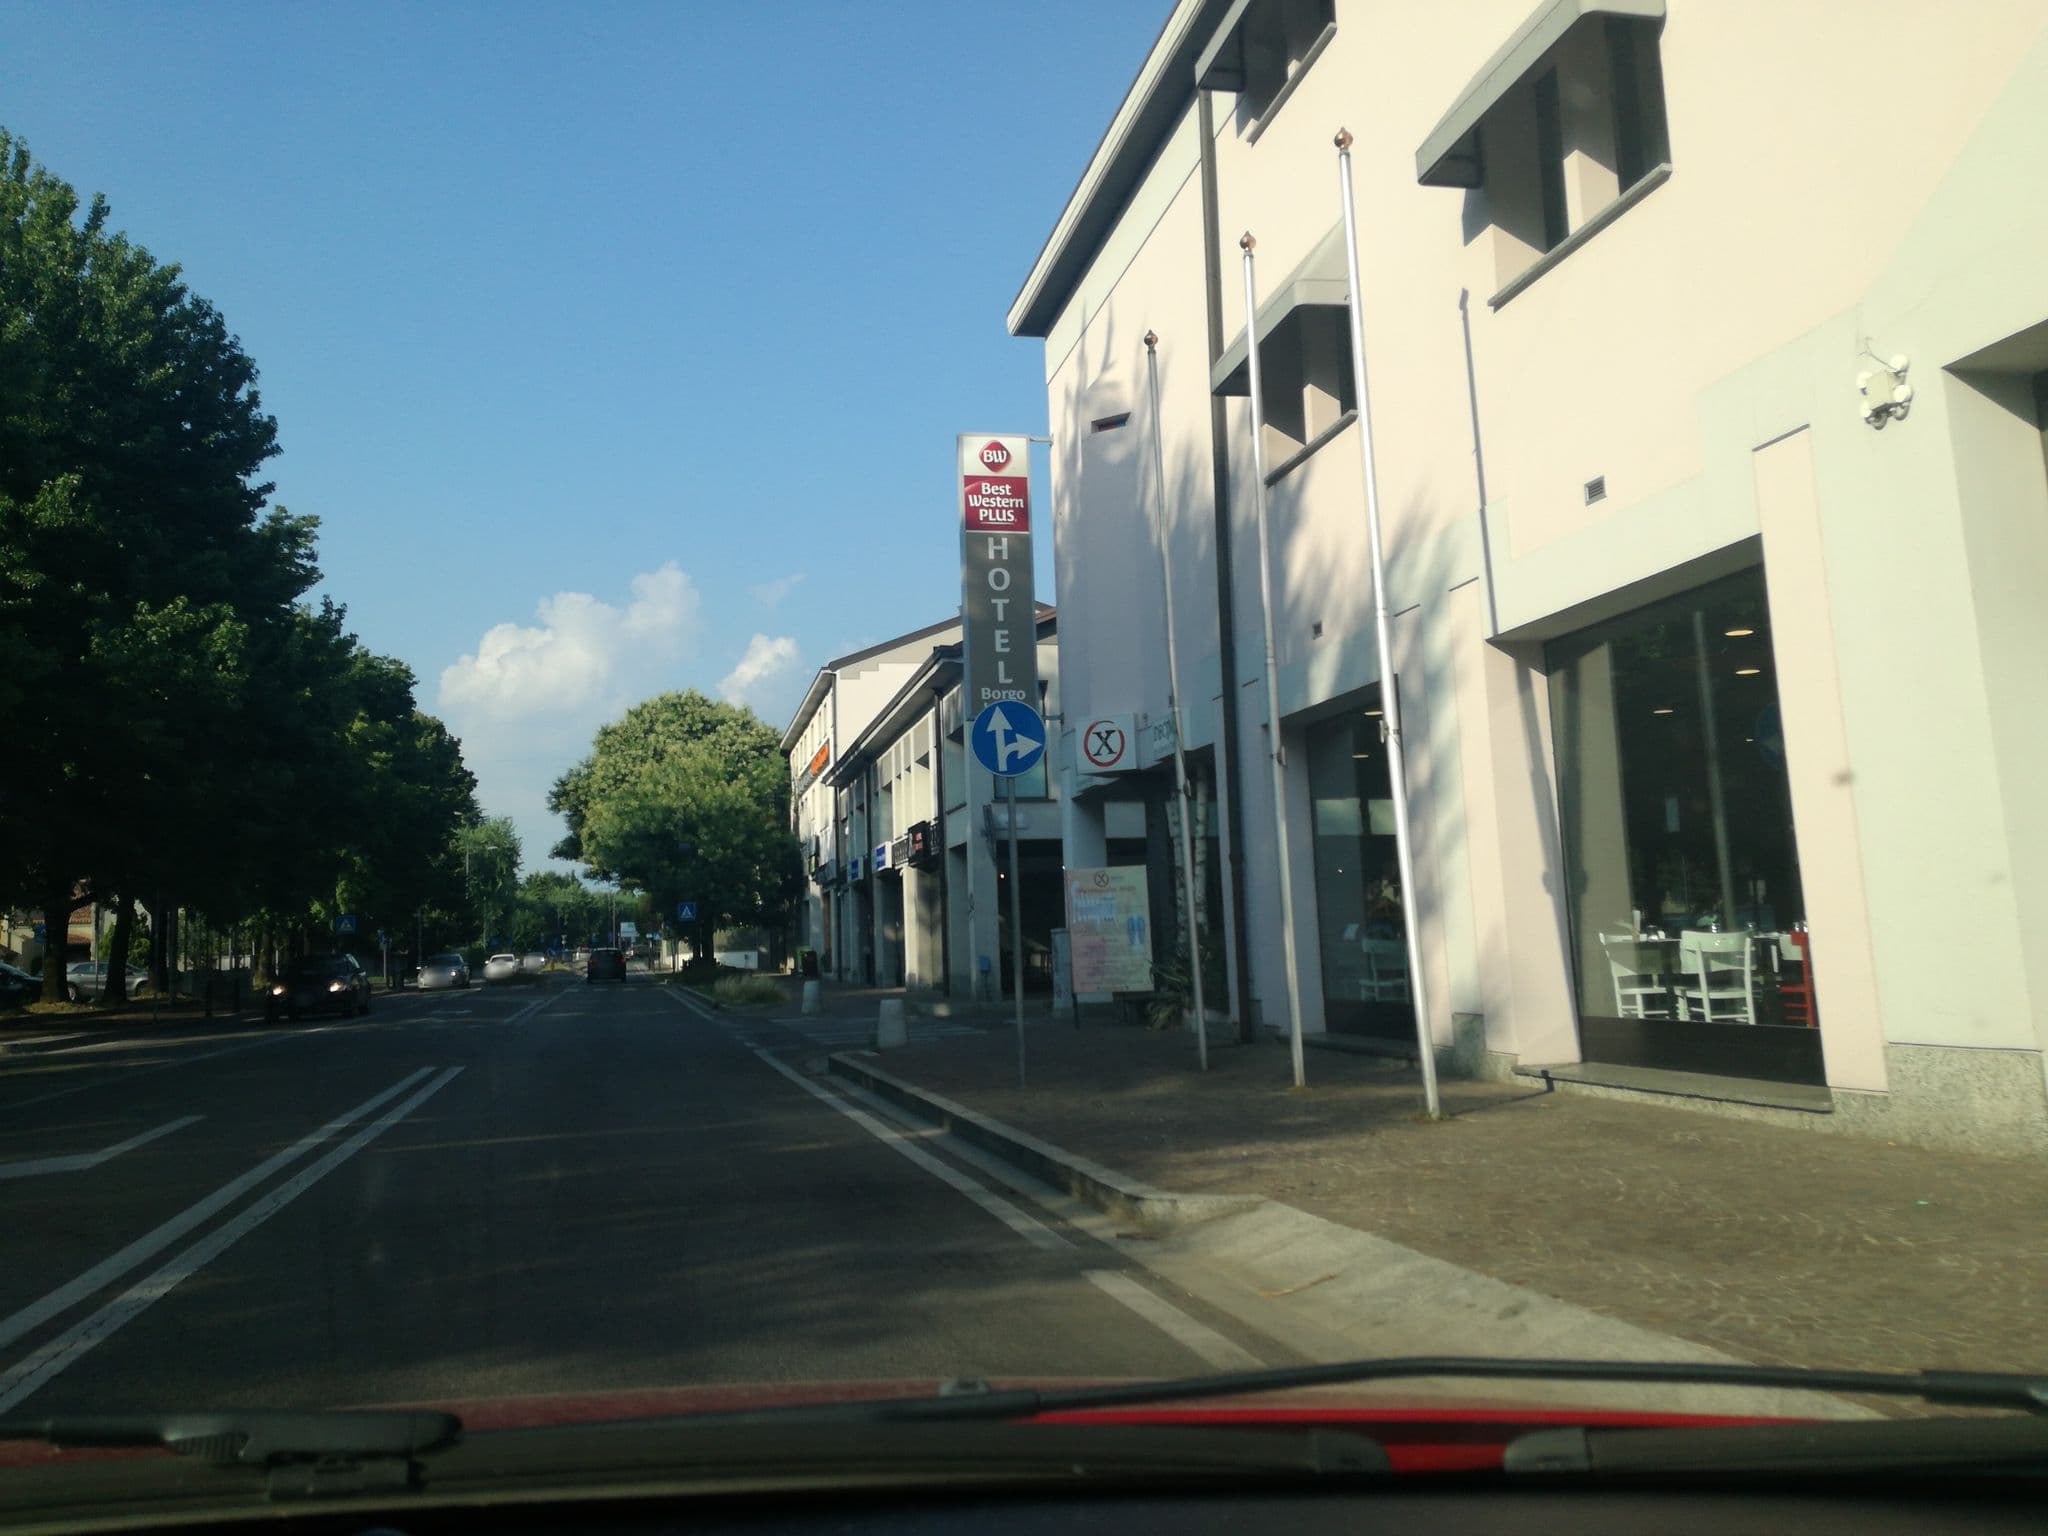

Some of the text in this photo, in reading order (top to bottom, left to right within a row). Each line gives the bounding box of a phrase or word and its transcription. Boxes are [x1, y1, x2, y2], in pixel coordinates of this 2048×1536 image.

[983, 449, 1007, 463] BW
[982, 483, 1011, 495] Best
[968, 494, 1024, 508] Western
[979, 509, 1014, 522] PLUS
[987, 536, 1013, 684] HOTEL
[981, 687, 1026, 701] Borgo
[1092, 729, 1116, 757] X
